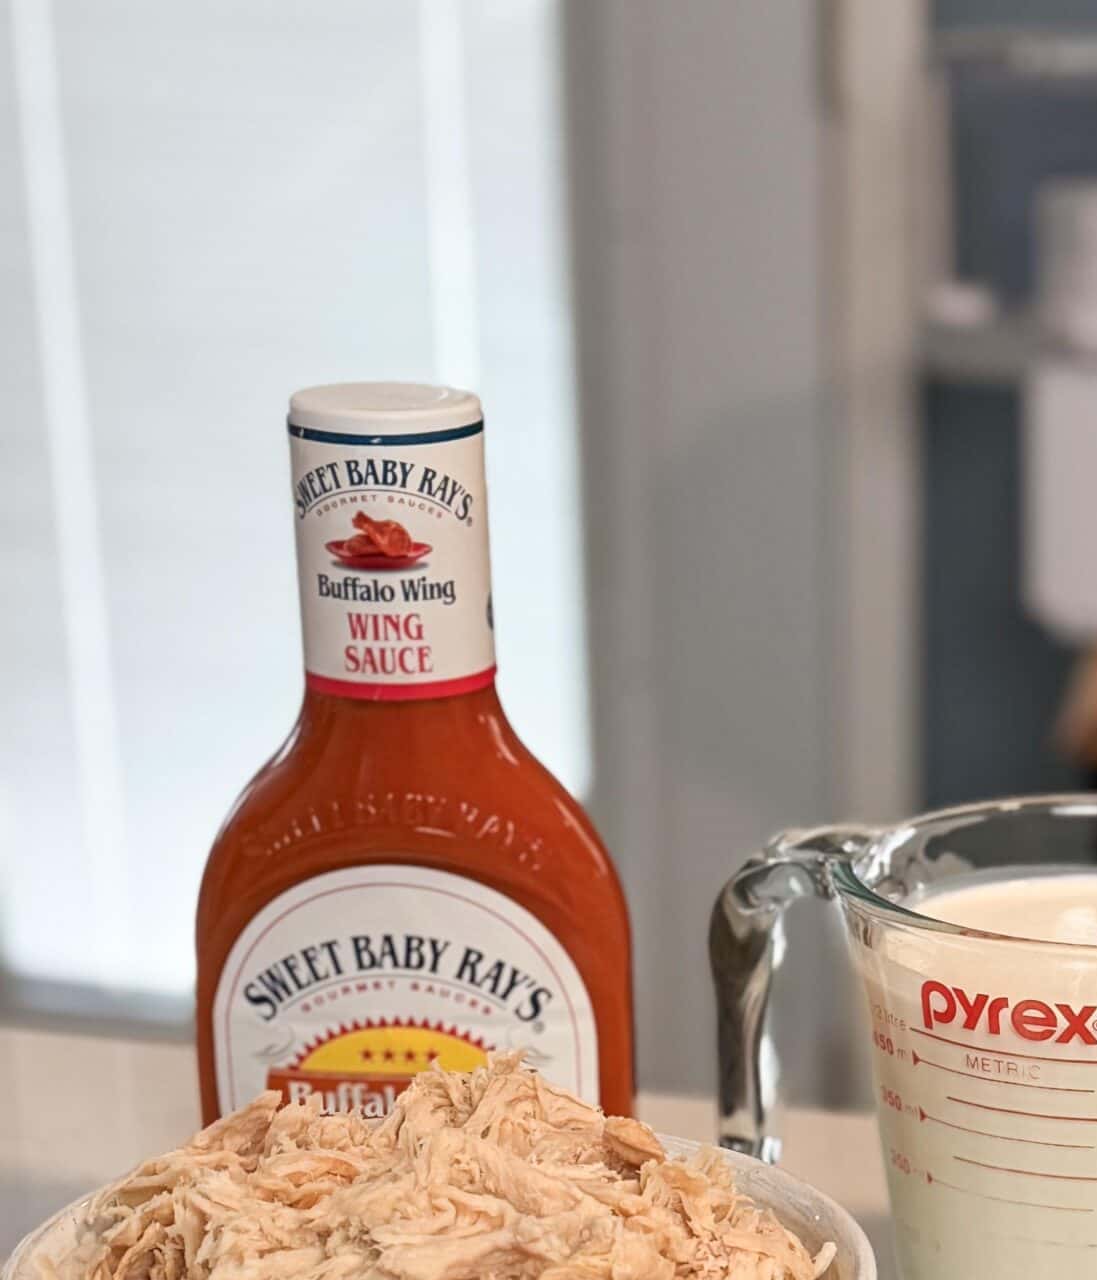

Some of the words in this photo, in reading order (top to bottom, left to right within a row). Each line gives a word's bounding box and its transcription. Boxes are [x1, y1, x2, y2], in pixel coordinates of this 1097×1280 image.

[295, 460, 342, 520] SWEET
[345, 458, 415, 487] BABY
[418, 466, 474, 522] RAY'S
[317, 573, 395, 602] Buffalo
[400, 576, 456, 605] Wing
[347, 612, 425, 642] WING
[344, 645, 433, 674] SAUCE
[242, 938, 345, 1022] SWEET
[351, 933, 452, 980] BABY
[455, 946, 553, 1024] RAY'S
[965, 1053, 1041, 1080] METRIC
[287, 1080, 396, 1119] Buffal
